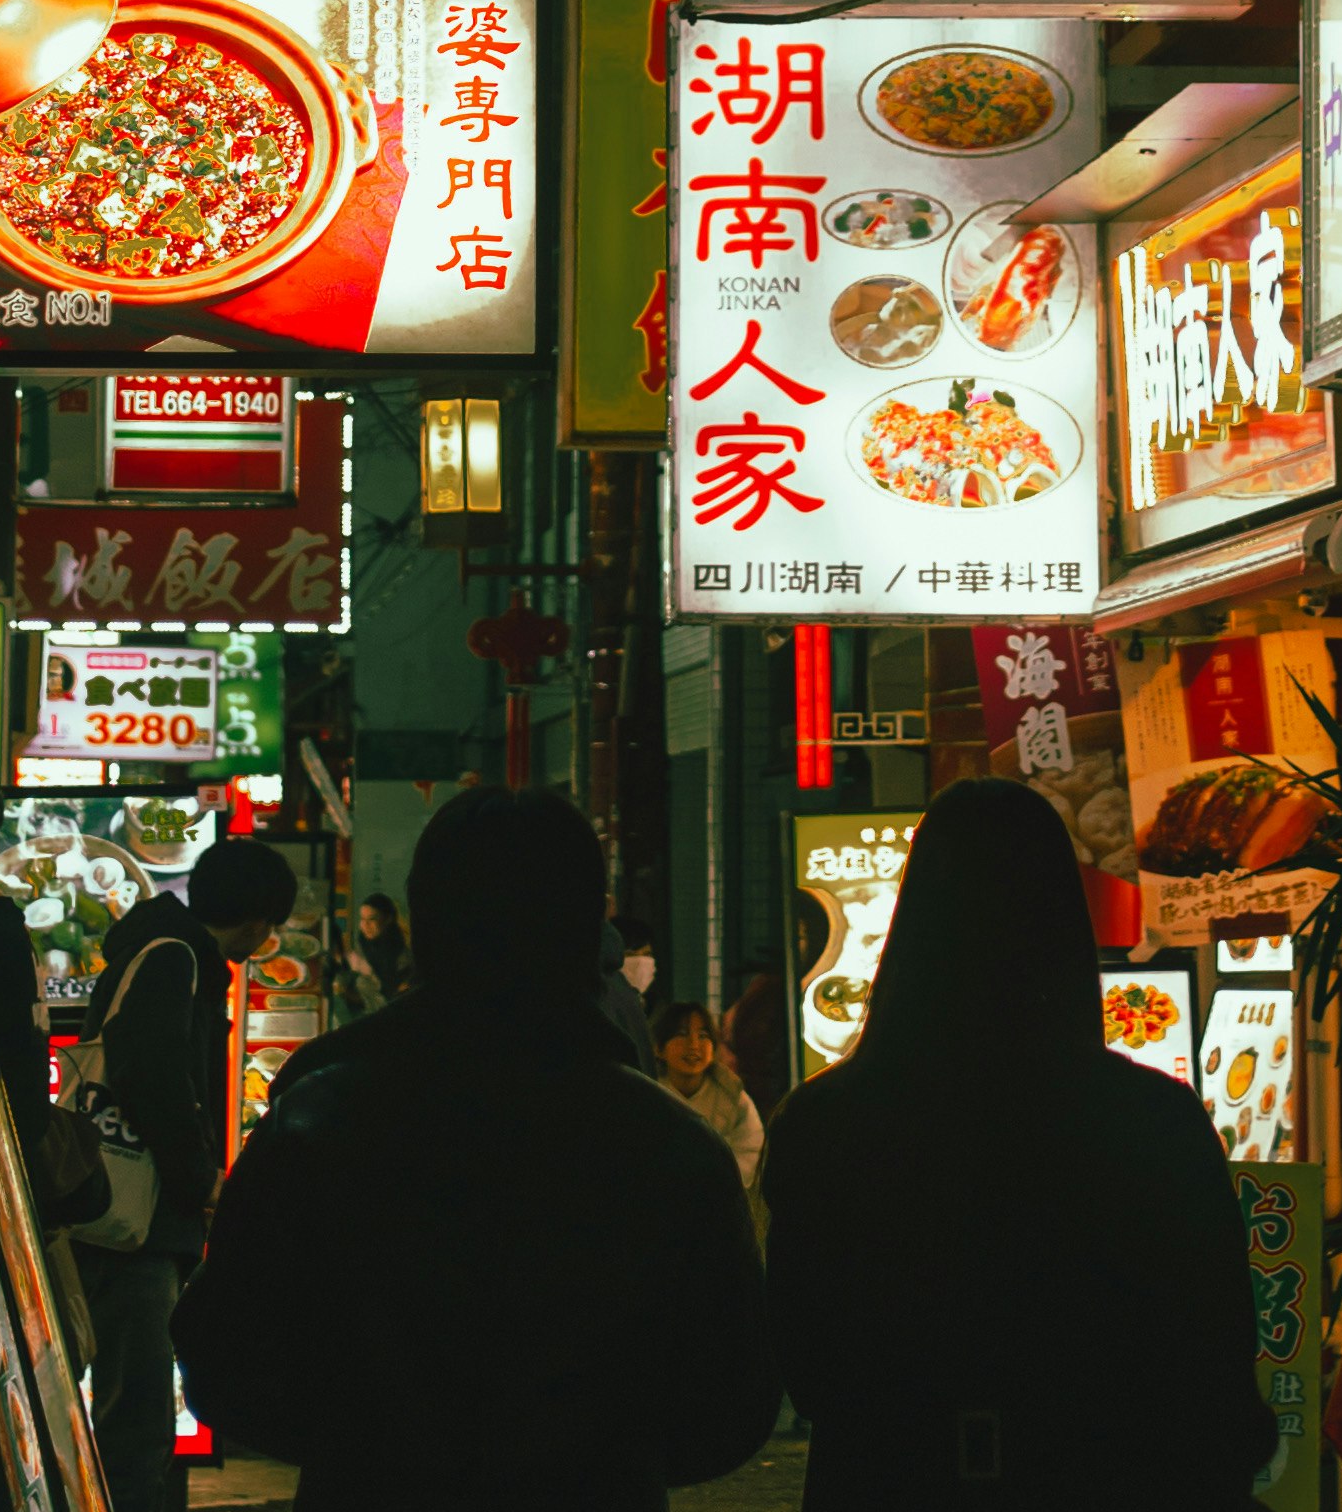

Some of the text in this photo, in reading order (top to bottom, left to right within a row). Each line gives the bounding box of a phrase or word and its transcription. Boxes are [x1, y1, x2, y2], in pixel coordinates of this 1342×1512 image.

[687, 36, 827, 531] 湖南人家
[718, 276, 801, 293] KONAN
[47, 290, 112, 326] NO.1
[718, 295, 782, 310] JINKA
[16, 527, 337, 613] 城飯店
[85, 712, 196, 746] 3280
